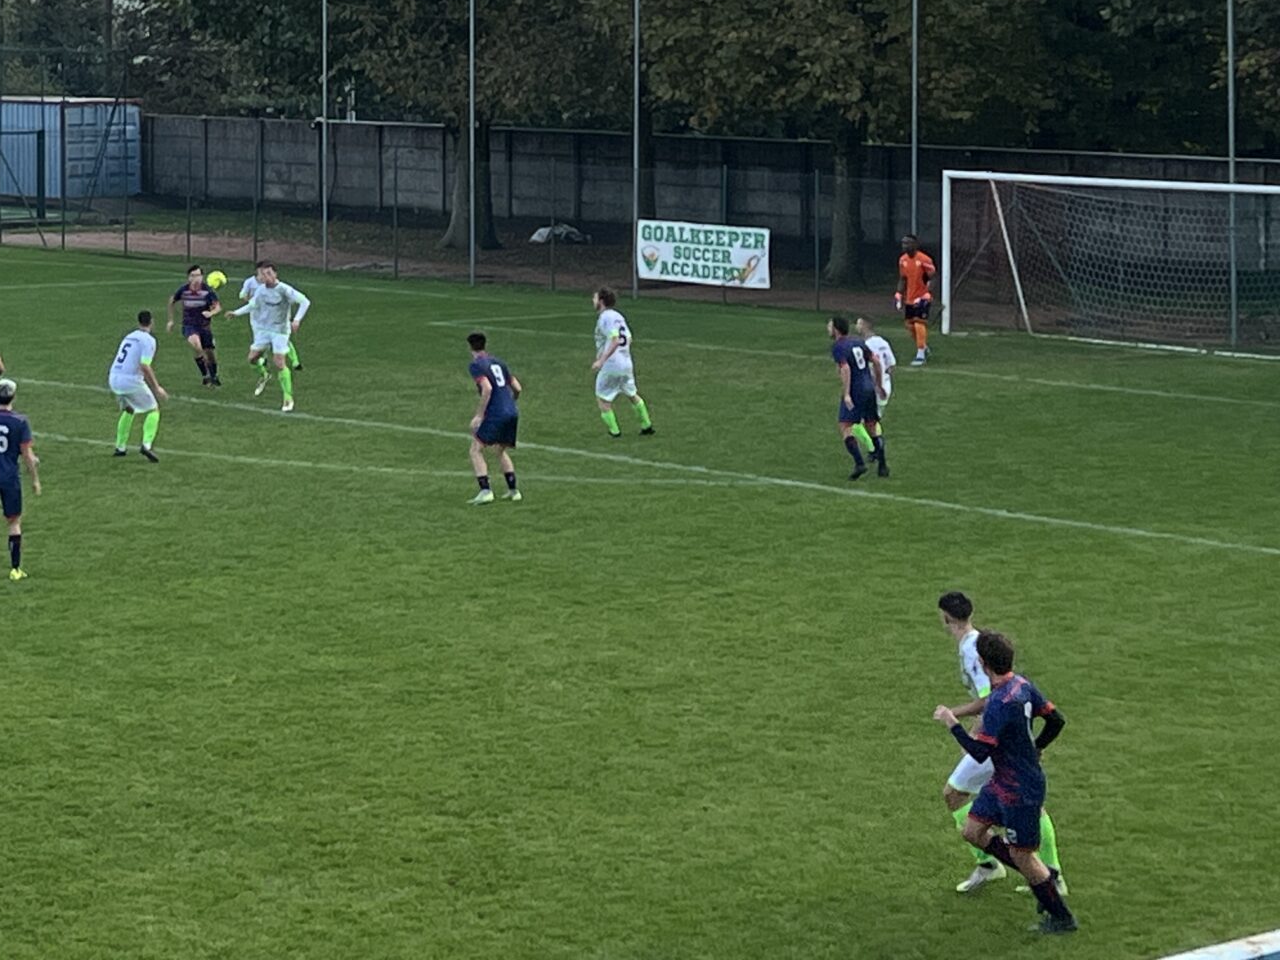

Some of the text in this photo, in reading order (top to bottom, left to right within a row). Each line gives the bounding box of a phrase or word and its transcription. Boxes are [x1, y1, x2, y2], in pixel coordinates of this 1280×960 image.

[641, 224, 766, 249] GOALKEEPER
[673, 245, 732, 264] SOCCER
[117, 343, 131, 364] 5
[852, 346, 866, 370] 8
